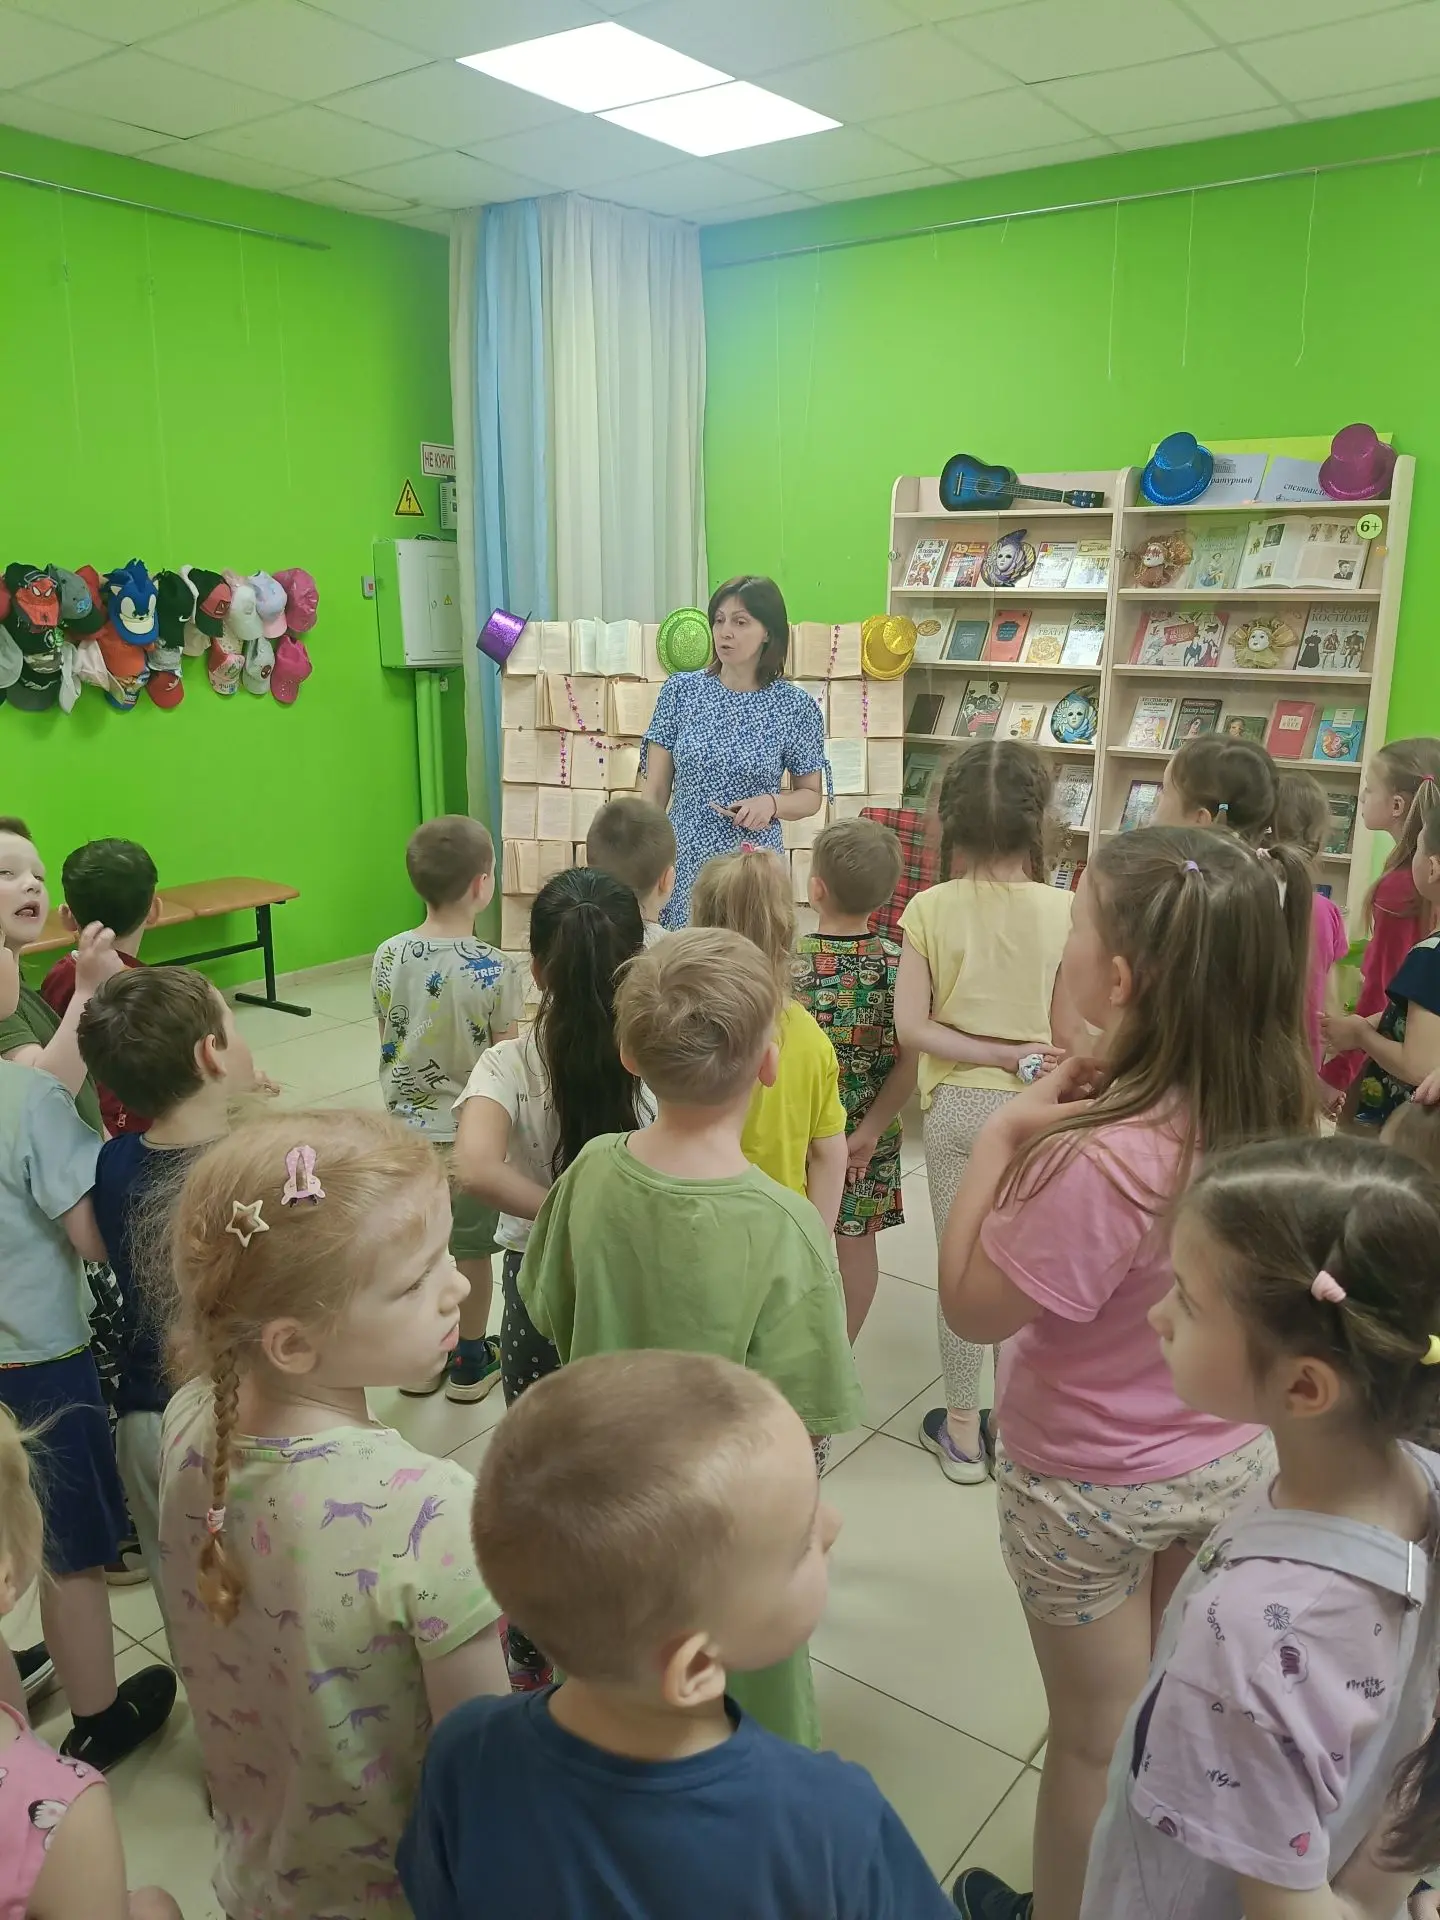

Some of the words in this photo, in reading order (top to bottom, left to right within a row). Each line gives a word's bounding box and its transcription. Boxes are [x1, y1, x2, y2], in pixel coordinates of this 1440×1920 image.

[424, 451, 434, 468] НЕ
[1360, 519, 1381, 533] 6+
[1311, 613, 1369, 623] КОСТЮМА
[469, 965, 505, 979] STREET
[417, 1058, 451, 1090] THE
